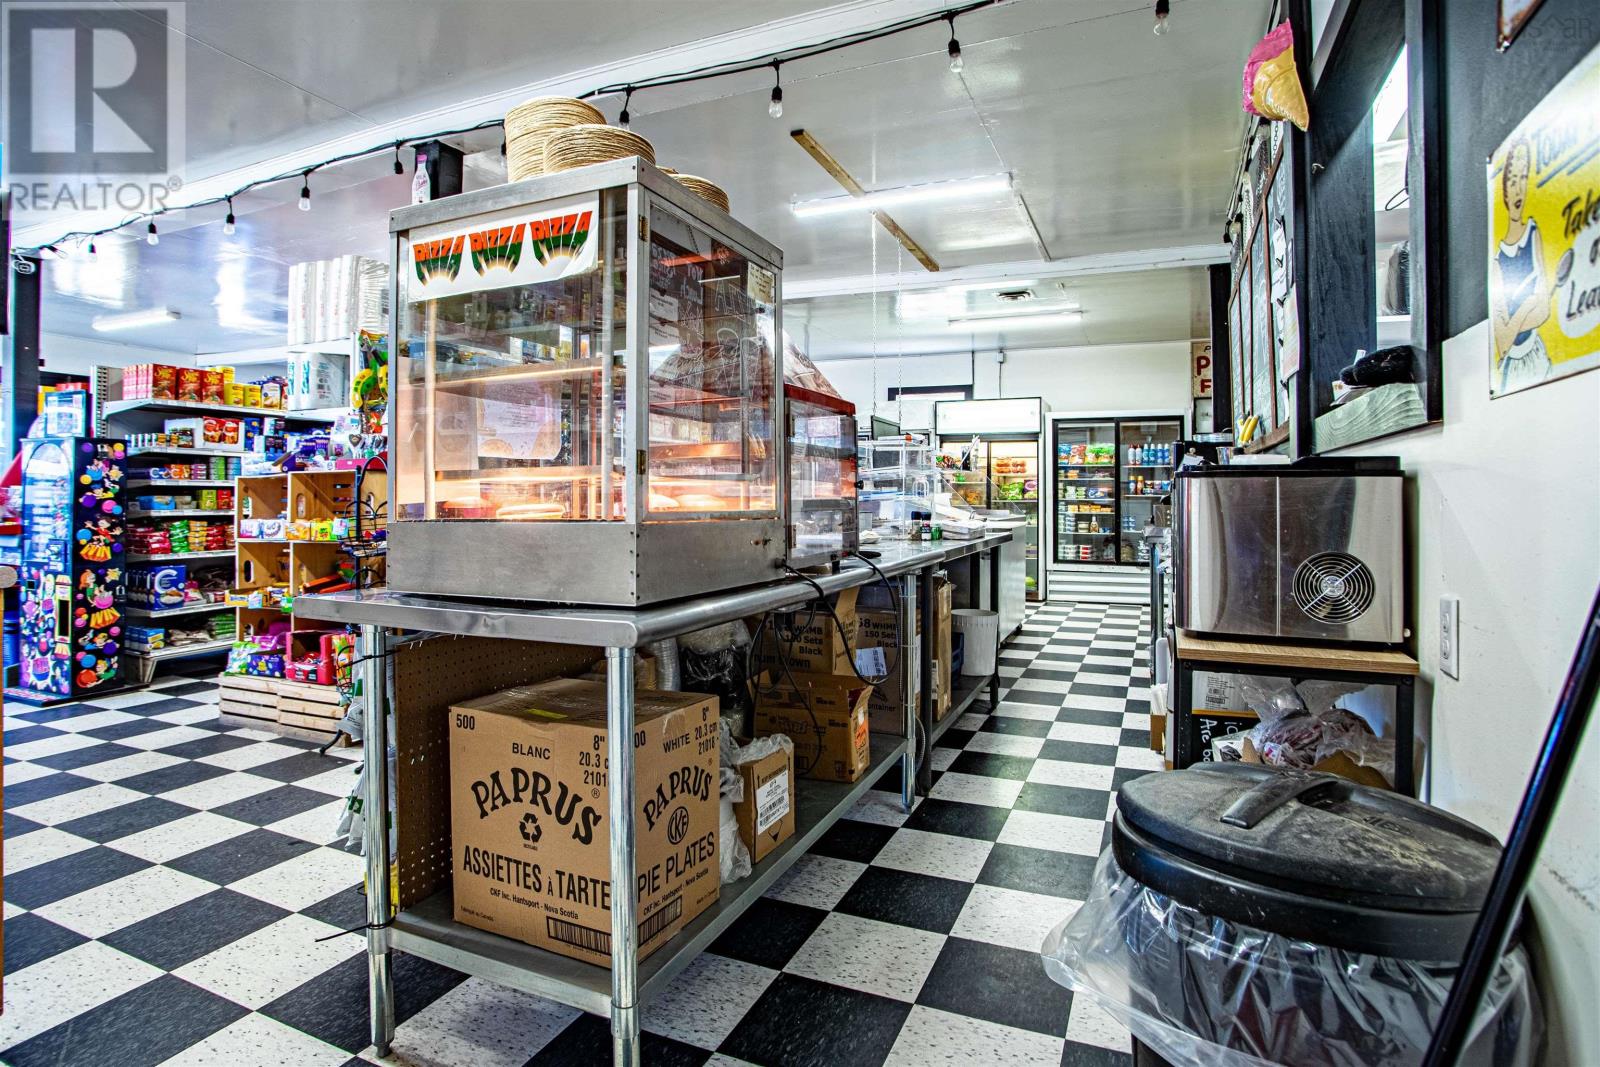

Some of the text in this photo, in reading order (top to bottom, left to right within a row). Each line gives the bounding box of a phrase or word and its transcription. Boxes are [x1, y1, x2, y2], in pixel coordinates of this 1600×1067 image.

[413, 210, 592, 262] PIZZA PIZZA PIZZA
[1566, 280, 1600, 318] Lea
[799, 646, 823, 656] Black
[456, 714, 476, 731] 500
[694, 724, 708, 740] 20.3
[593, 735, 605, 751] 8"
[634, 730, 647, 749] 00
[663, 732, 691, 753] WHITE
[512, 742, 551, 761] BLANC
[579, 751, 601, 769] 20.3
[584, 770, 607, 787] 2101
[470, 767, 602, 846] PAPRUS
[643, 765, 713, 832] PAPRUS
[668, 807, 689, 844] CKF
[463, 845, 542, 894] ASSIETTES
[555, 870, 611, 910] TARTE
[637, 831, 715, 904] PIE PLATES
[490, 887, 501, 897] CKF
[502, 891, 513, 901] Inc.
[512, 894, 541, 910] Hantsport
[544, 903, 559, 915] Nova
[559, 906, 580, 920] Scotia
